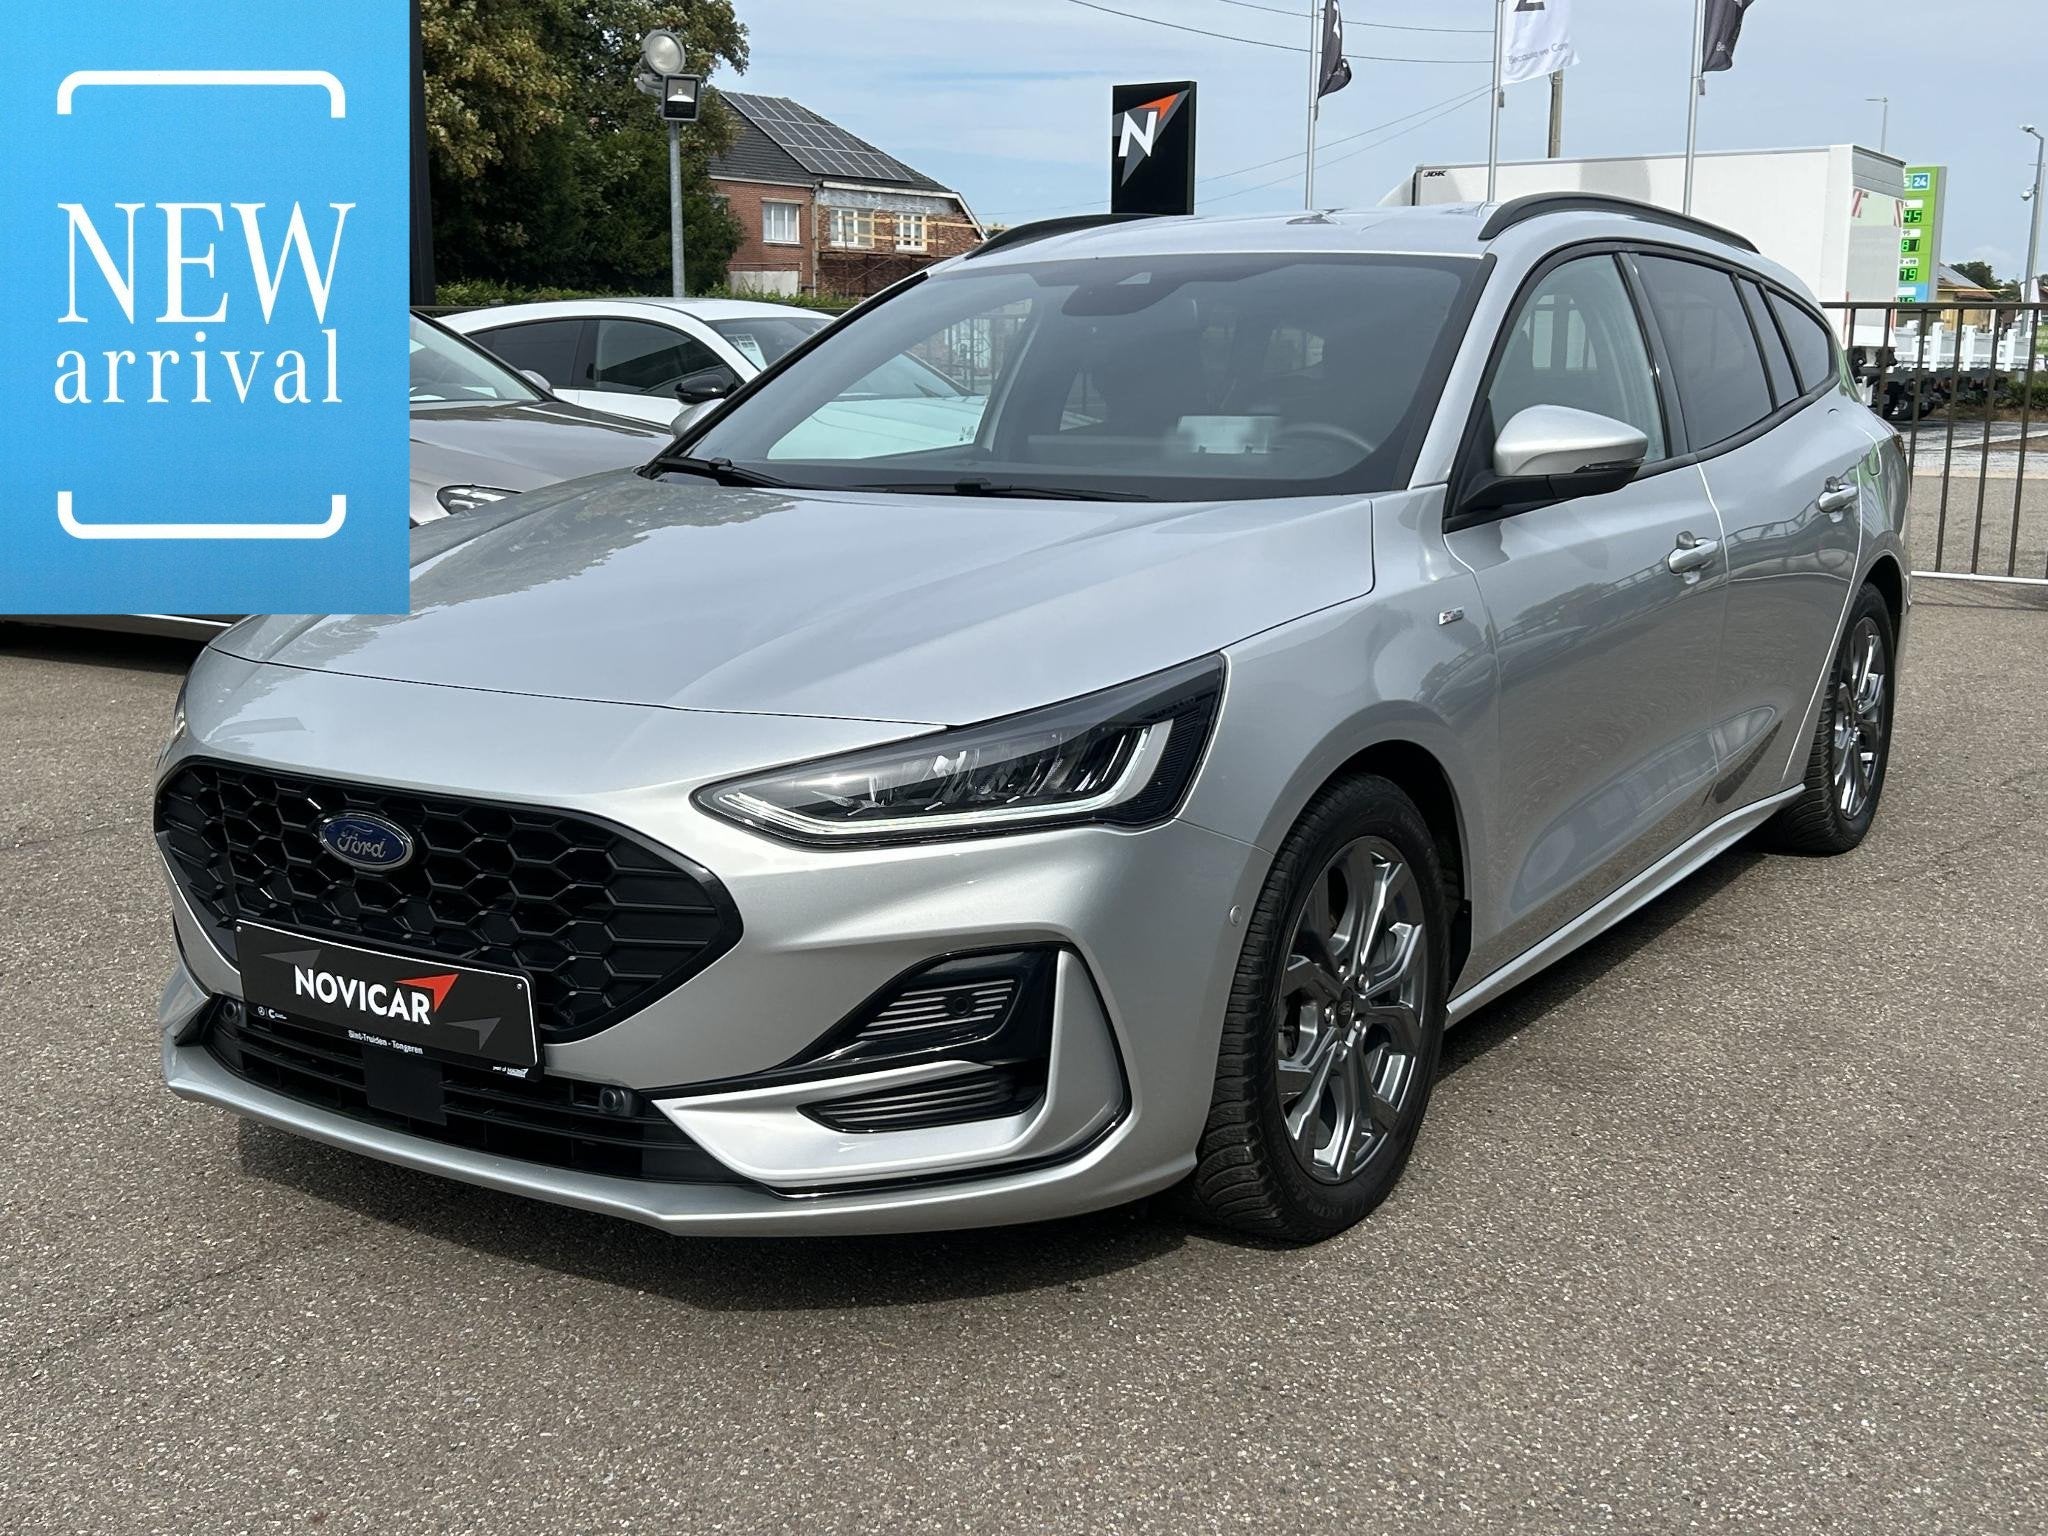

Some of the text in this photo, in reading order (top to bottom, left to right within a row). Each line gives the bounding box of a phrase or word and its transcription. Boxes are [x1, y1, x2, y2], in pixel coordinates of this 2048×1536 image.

[1913, 176, 1927, 187] 24
[337, 824, 386, 858] Ford
[294, 964, 431, 1026] NOVICAR
